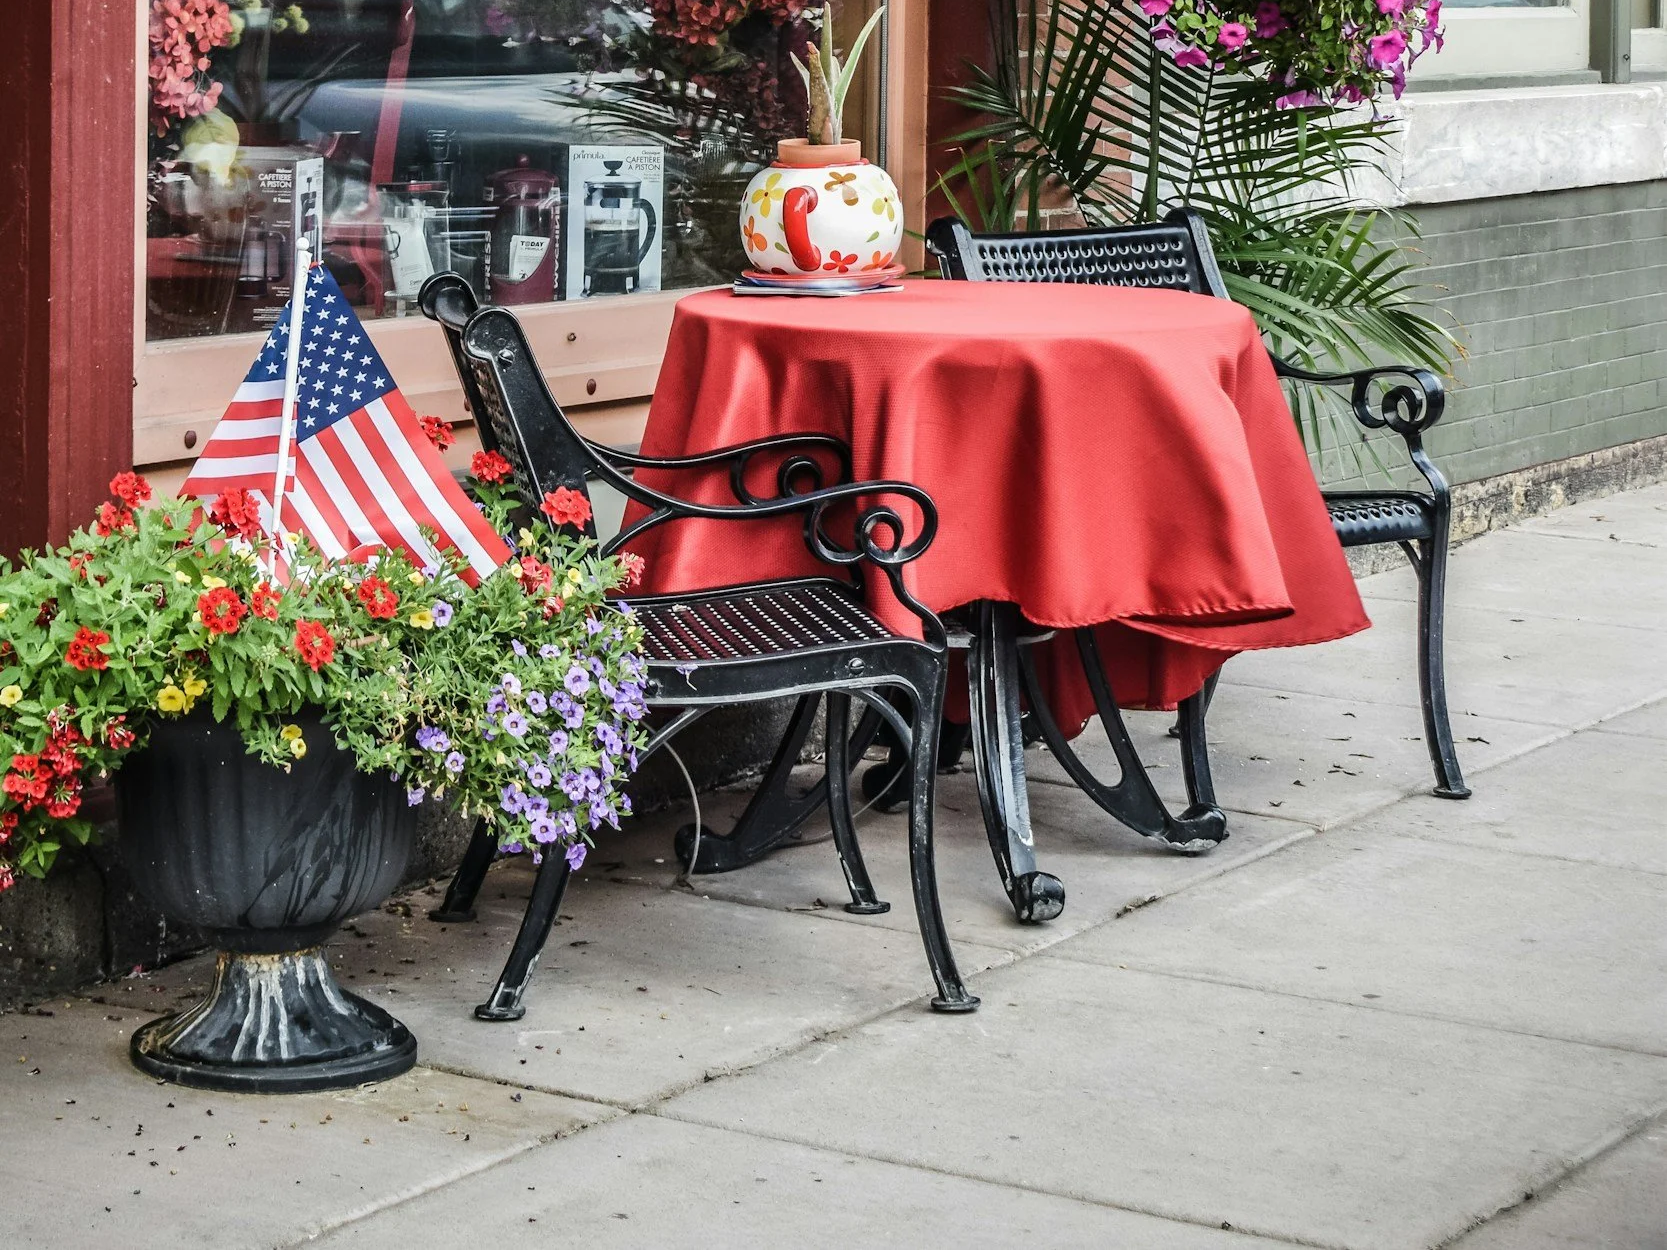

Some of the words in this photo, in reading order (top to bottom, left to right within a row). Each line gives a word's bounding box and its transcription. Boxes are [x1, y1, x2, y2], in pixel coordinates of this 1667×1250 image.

[634, 163, 661, 171] PISTON
[266, 180, 292, 188] PISTON
[520, 240, 545, 248] TODAY
[484, 231, 492, 290] PRESS
